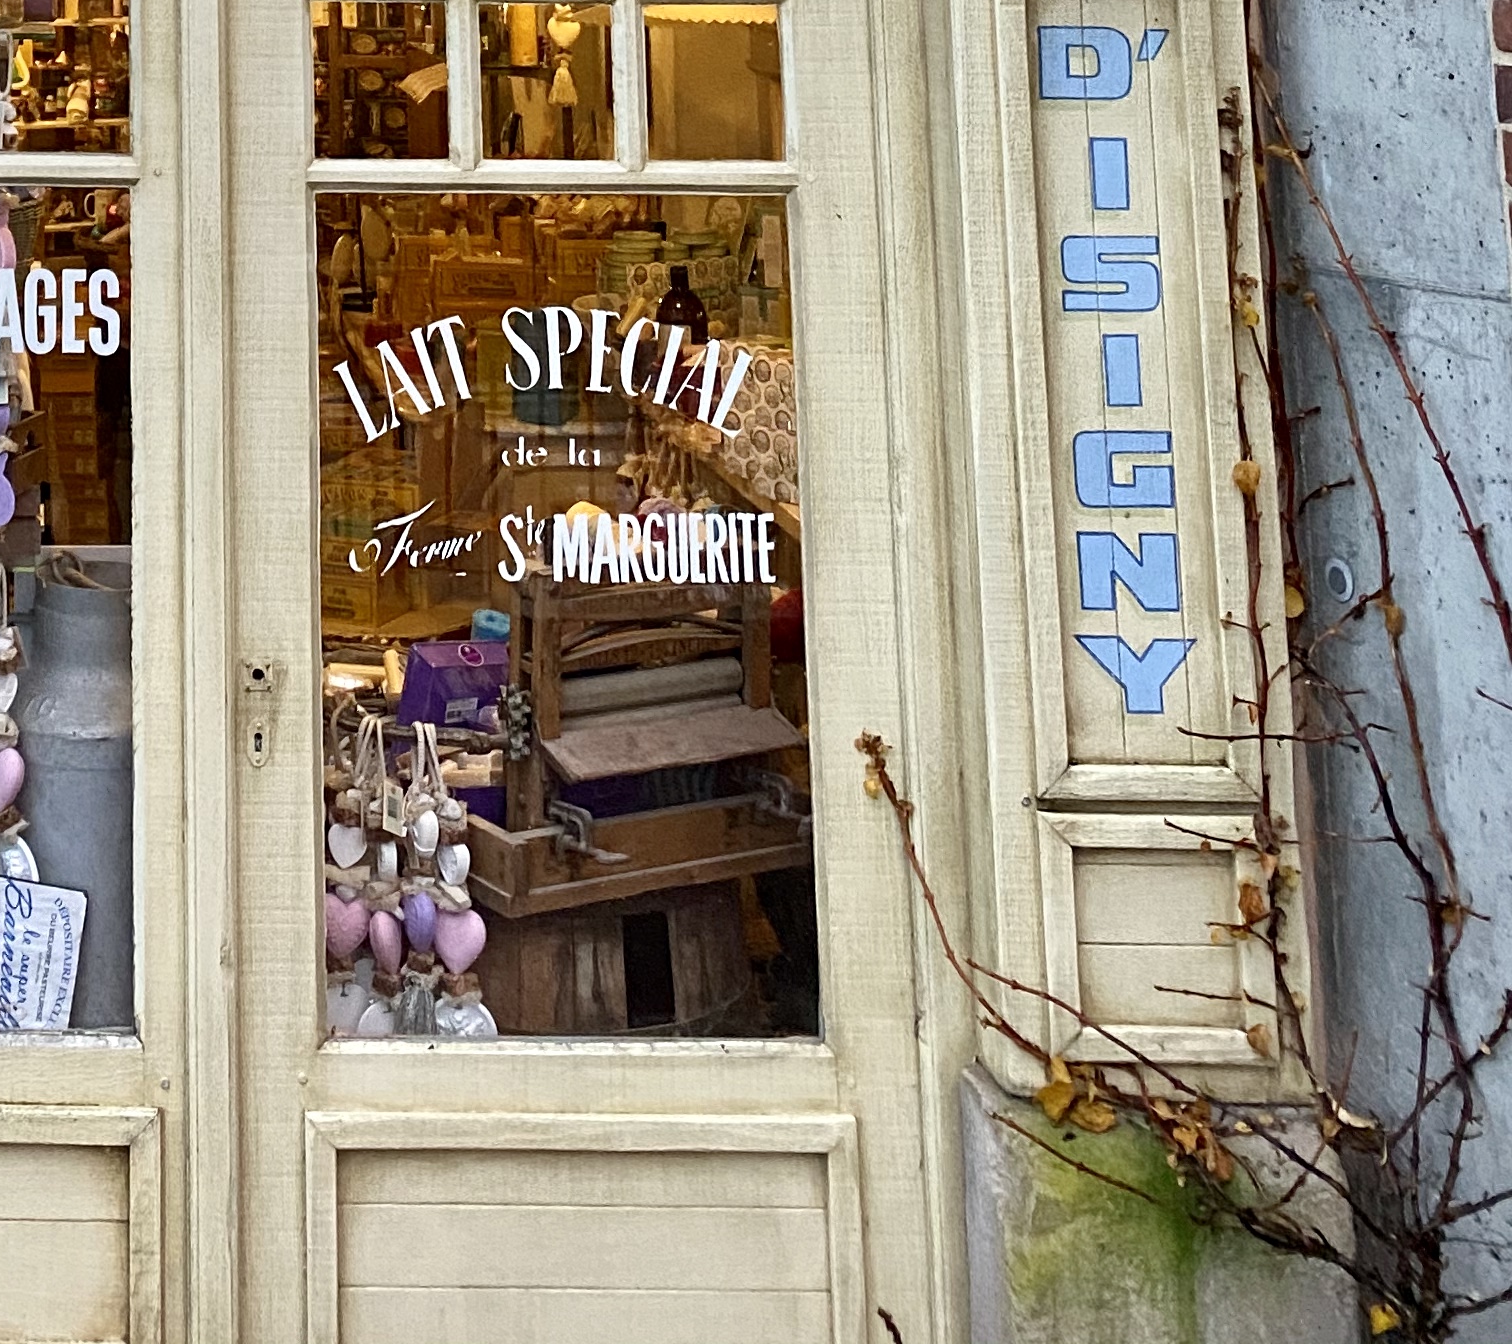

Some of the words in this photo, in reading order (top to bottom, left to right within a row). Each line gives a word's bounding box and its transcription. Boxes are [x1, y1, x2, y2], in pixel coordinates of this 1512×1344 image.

[332, 314, 474, 443] LAIT
[500, 305, 754, 439] SPECIAL
[1036, 24, 1198, 715] D'ISIGNY
[501, 436, 548, 467] de
[568, 438, 602, 467] la
[552, 512, 777, 584] MARGUERITE
[21, 927, 41, 945] le
[13, 953, 30, 1004] super
